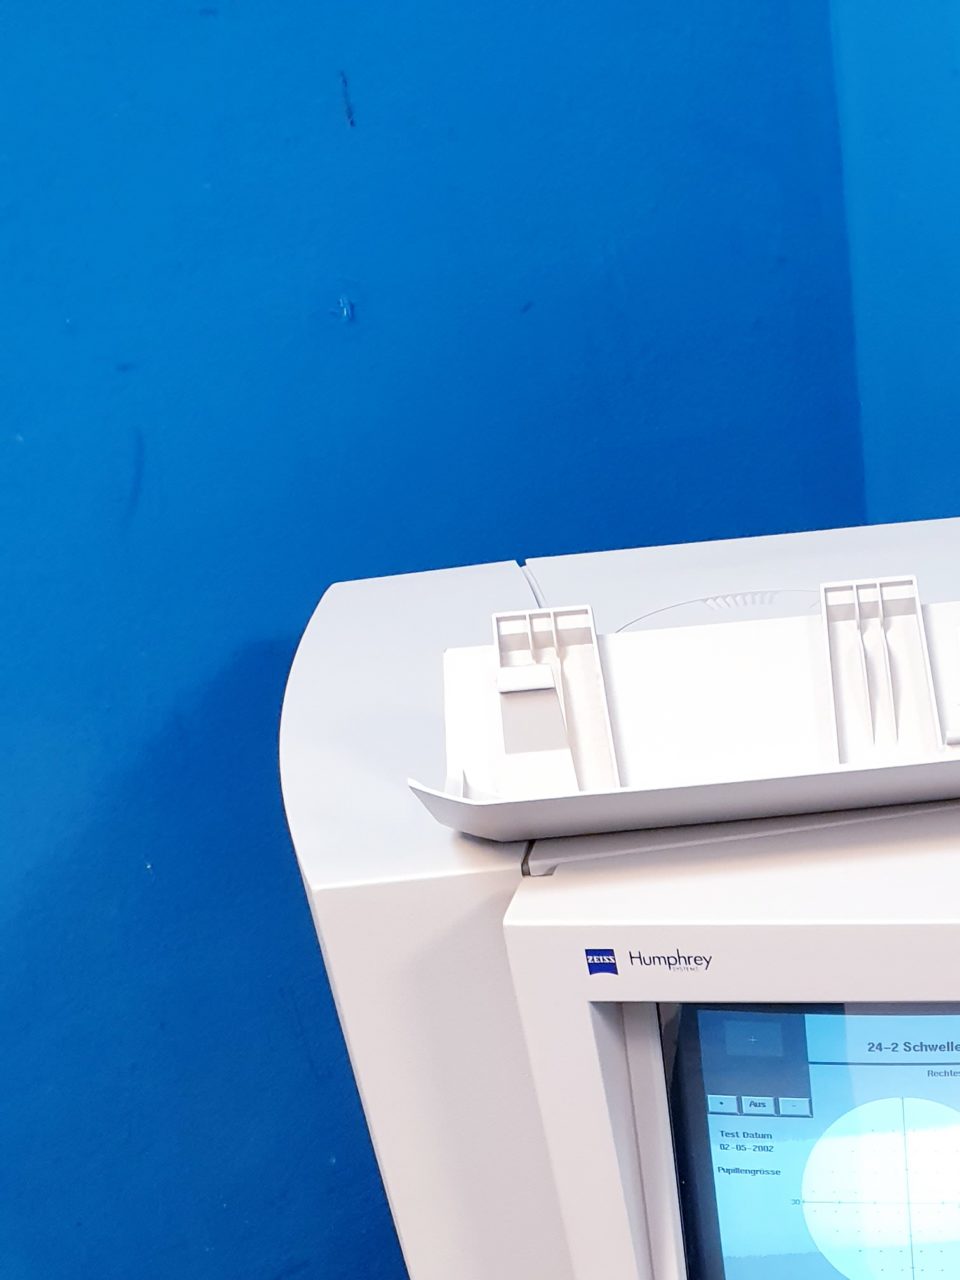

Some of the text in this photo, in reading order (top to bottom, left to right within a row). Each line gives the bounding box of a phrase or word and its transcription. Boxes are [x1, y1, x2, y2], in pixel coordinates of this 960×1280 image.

[587, 955, 616, 964] ZEISS
[629, 948, 713, 971] Humphrey
[867, 1041, 899, 1053] 24-2
[749, 1100, 766, 1108] Aus
[720, 1130, 773, 1140] Test Datum
[719, 1143, 774, 1153] 02-05-2002
